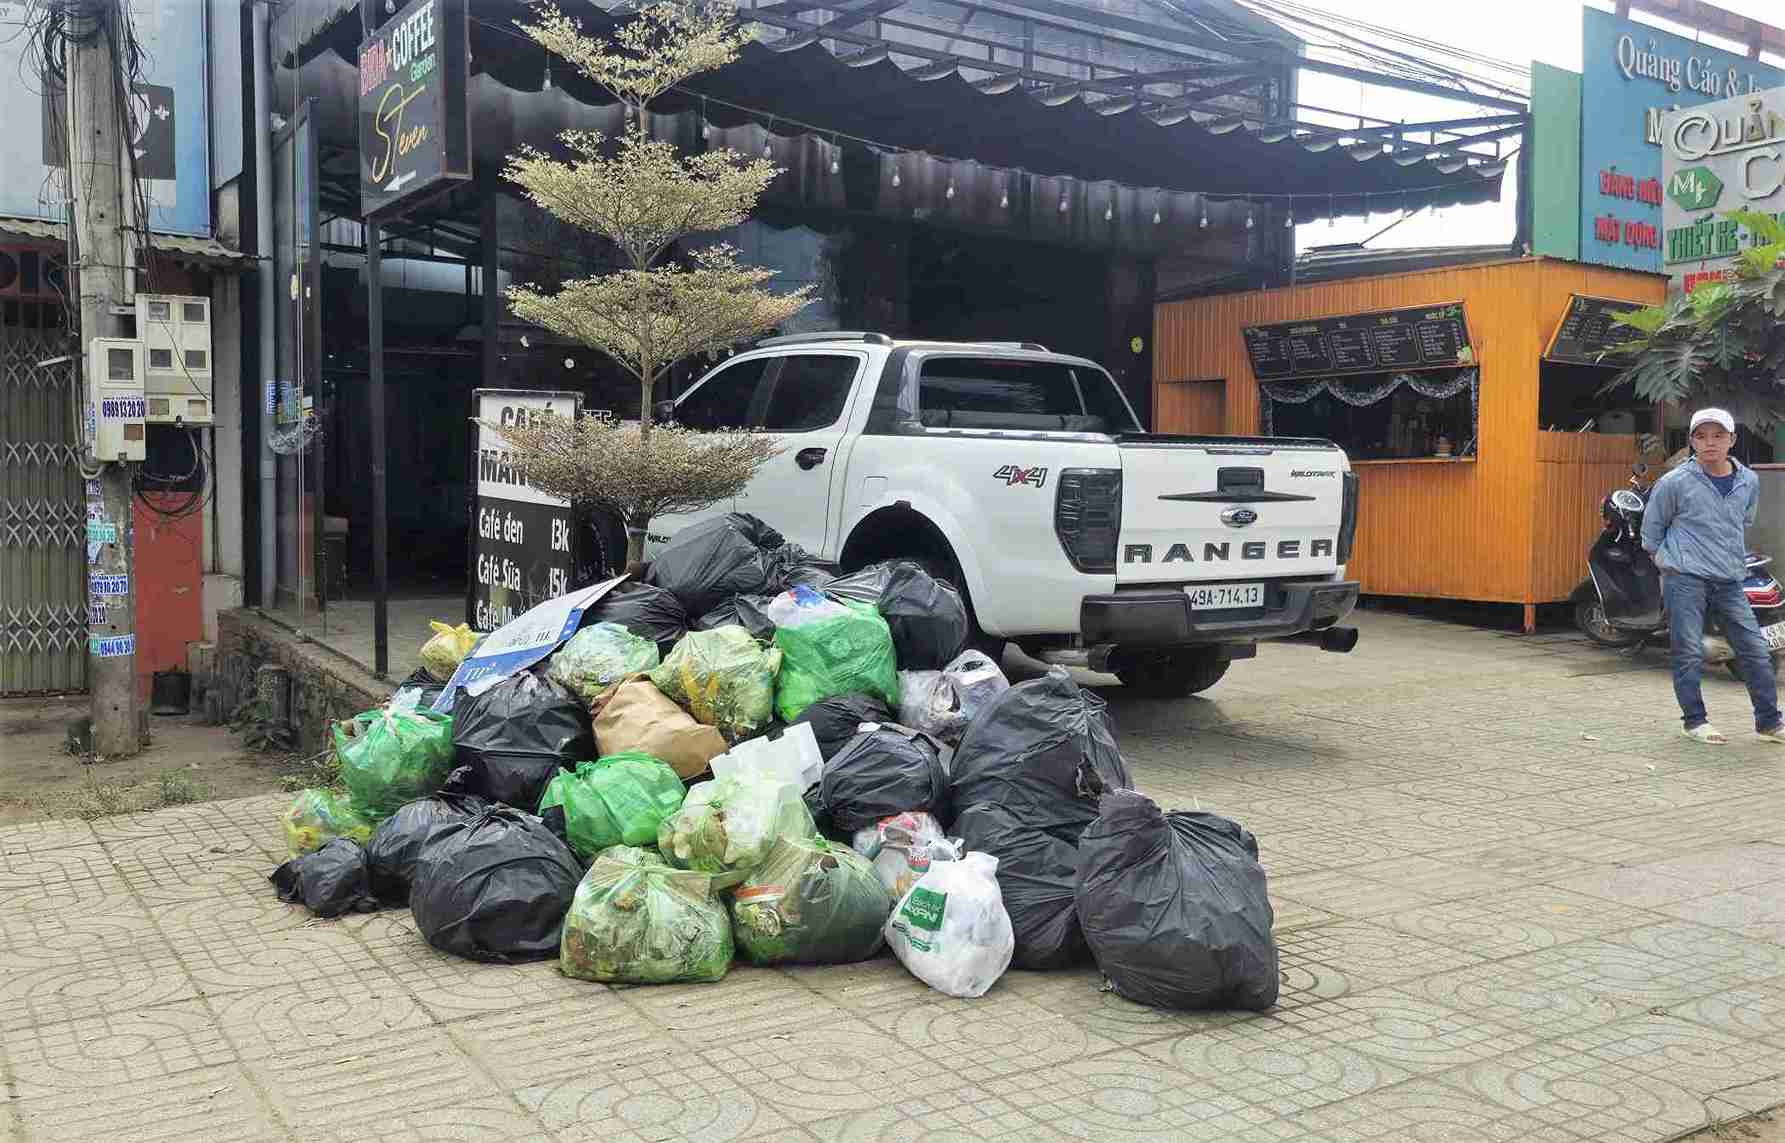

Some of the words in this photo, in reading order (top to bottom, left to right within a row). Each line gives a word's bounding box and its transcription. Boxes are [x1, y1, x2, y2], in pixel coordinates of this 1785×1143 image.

[392, 0, 435, 71] COFFEE
[1618, 35, 1681, 92] Quảng
[1687, 57, 1721, 96] Cáo
[479, 507, 500, 540] Café
[1123, 538, 1334, 564] RANGER
[478, 553, 500, 586] Café
[1190, 587, 1259, 606] 49A-714.13
